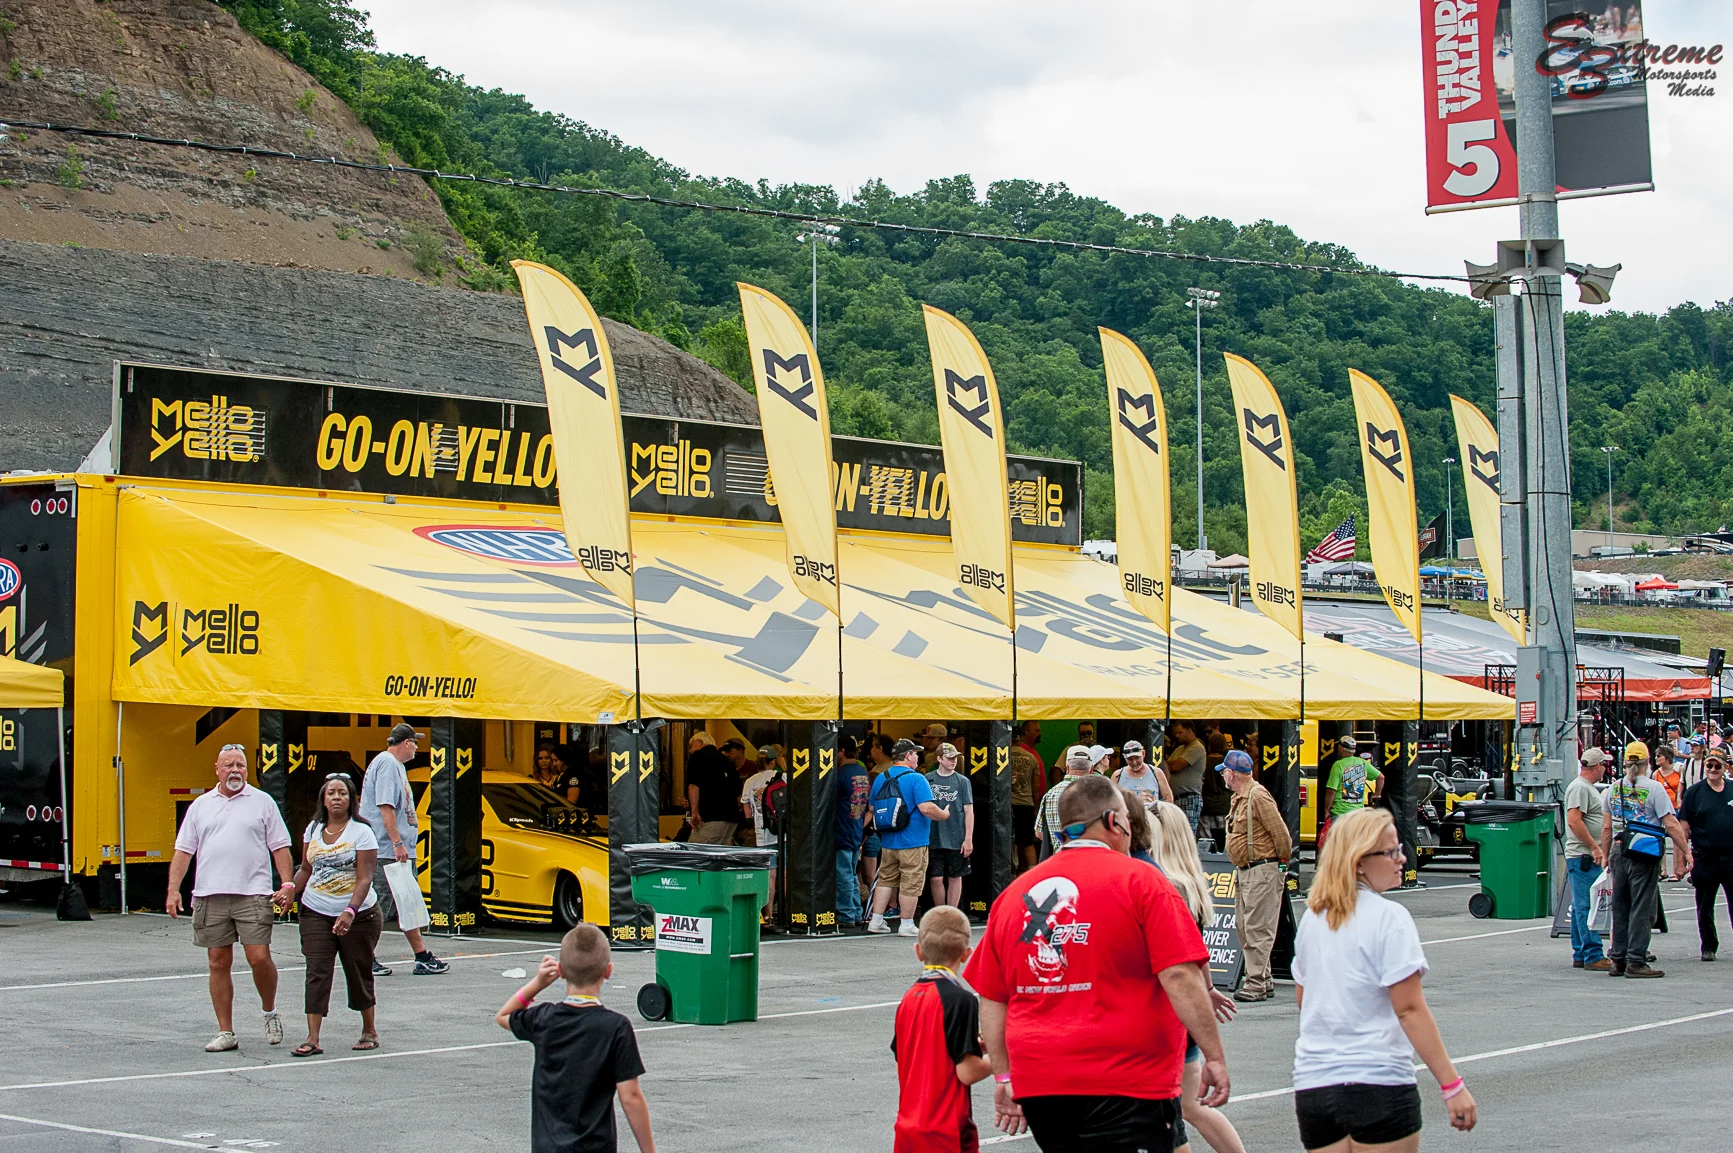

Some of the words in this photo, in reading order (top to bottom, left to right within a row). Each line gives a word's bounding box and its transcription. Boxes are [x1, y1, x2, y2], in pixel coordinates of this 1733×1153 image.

[1434, 0, 1461, 119] THUND
[1442, 119, 1501, 197] 5
[631, 439, 712, 473] Mello
[630, 468, 711, 498] Yello
[182, 604, 260, 631] Mello
[181, 631, 259, 657] Yello
[385, 675, 478, 699] GO-ON-YELLO!
[1050, 923, 1091, 945] 275
[1202, 931, 1230, 947] RIVER
